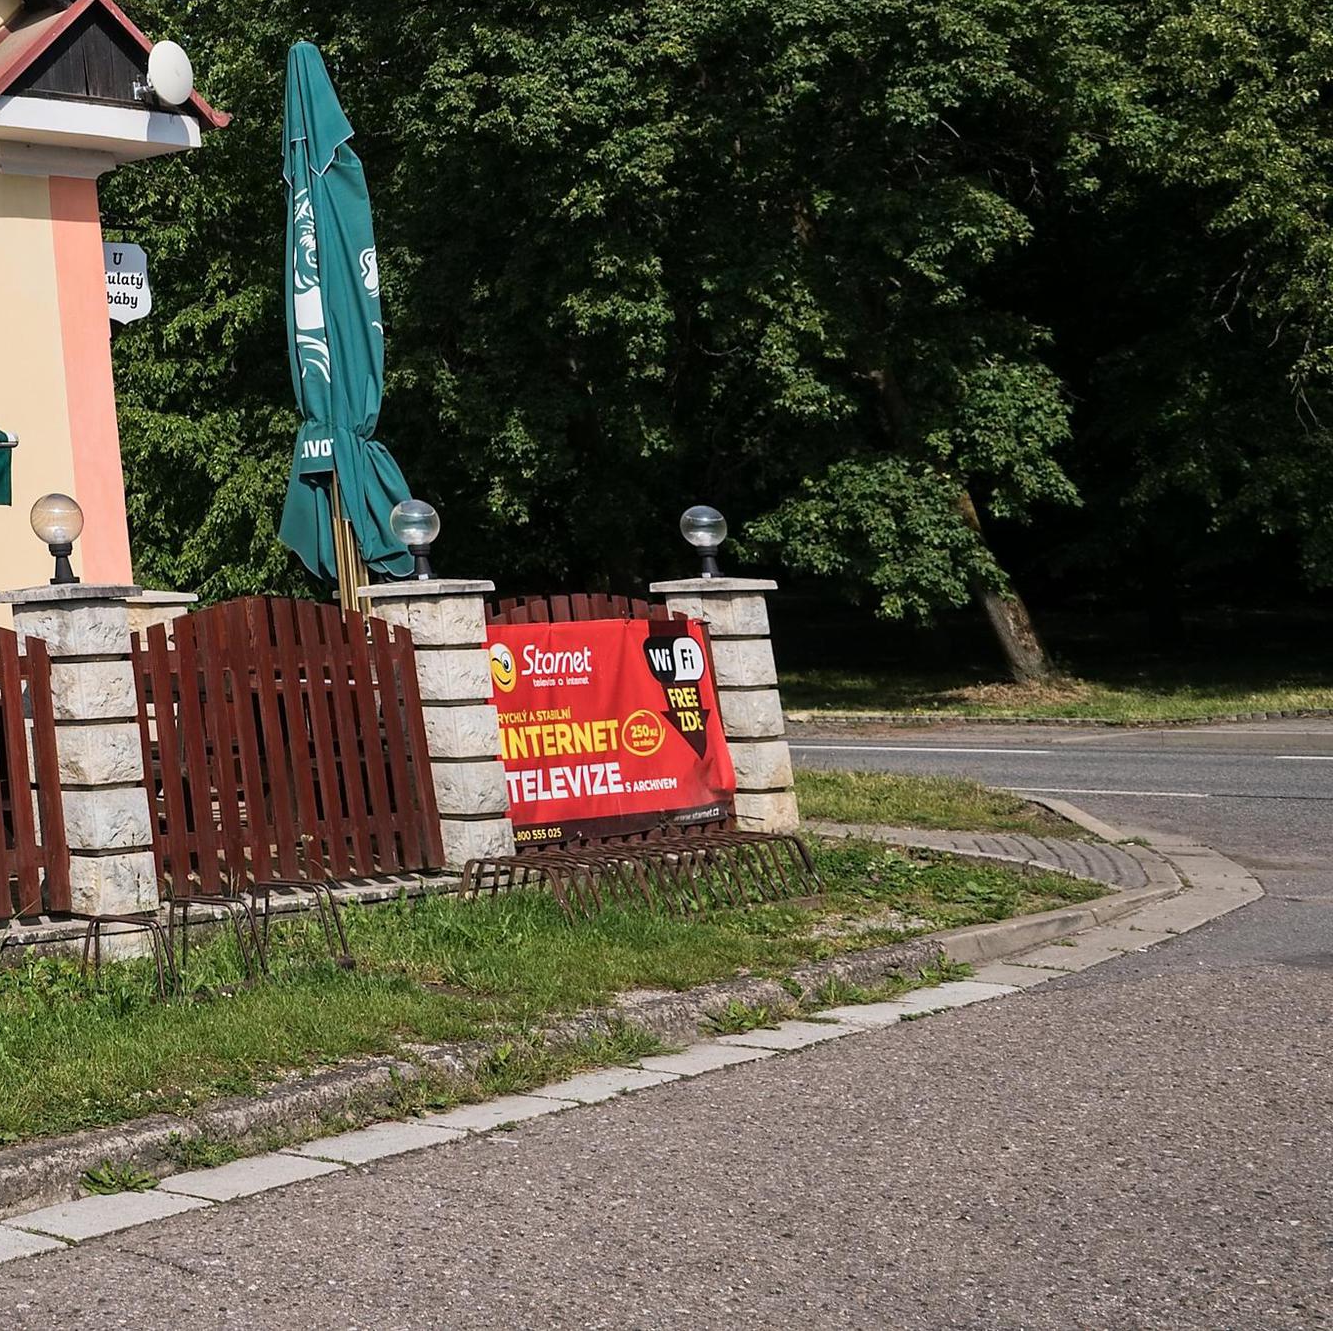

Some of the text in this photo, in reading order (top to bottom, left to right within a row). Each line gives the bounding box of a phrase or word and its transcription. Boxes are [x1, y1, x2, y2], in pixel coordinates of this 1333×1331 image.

[113, 253, 123, 265] U
[105, 272, 143, 289] ulatý
[107, 291, 138, 309] báby
[301, 438, 333, 459] IVO
[521, 644, 592, 676] Starnet
[667, 687, 699, 708] FREE
[497, 706, 571, 725] RYCHLÝ A STABILNÍ
[677, 710, 704, 732] ZDE
[499, 720, 619, 760] INTERNET
[630, 724, 650, 738] 250
[505, 762, 677, 803] TELEVIZE S ARCHIVEM
[517, 827, 562, 841] 800 555 025
